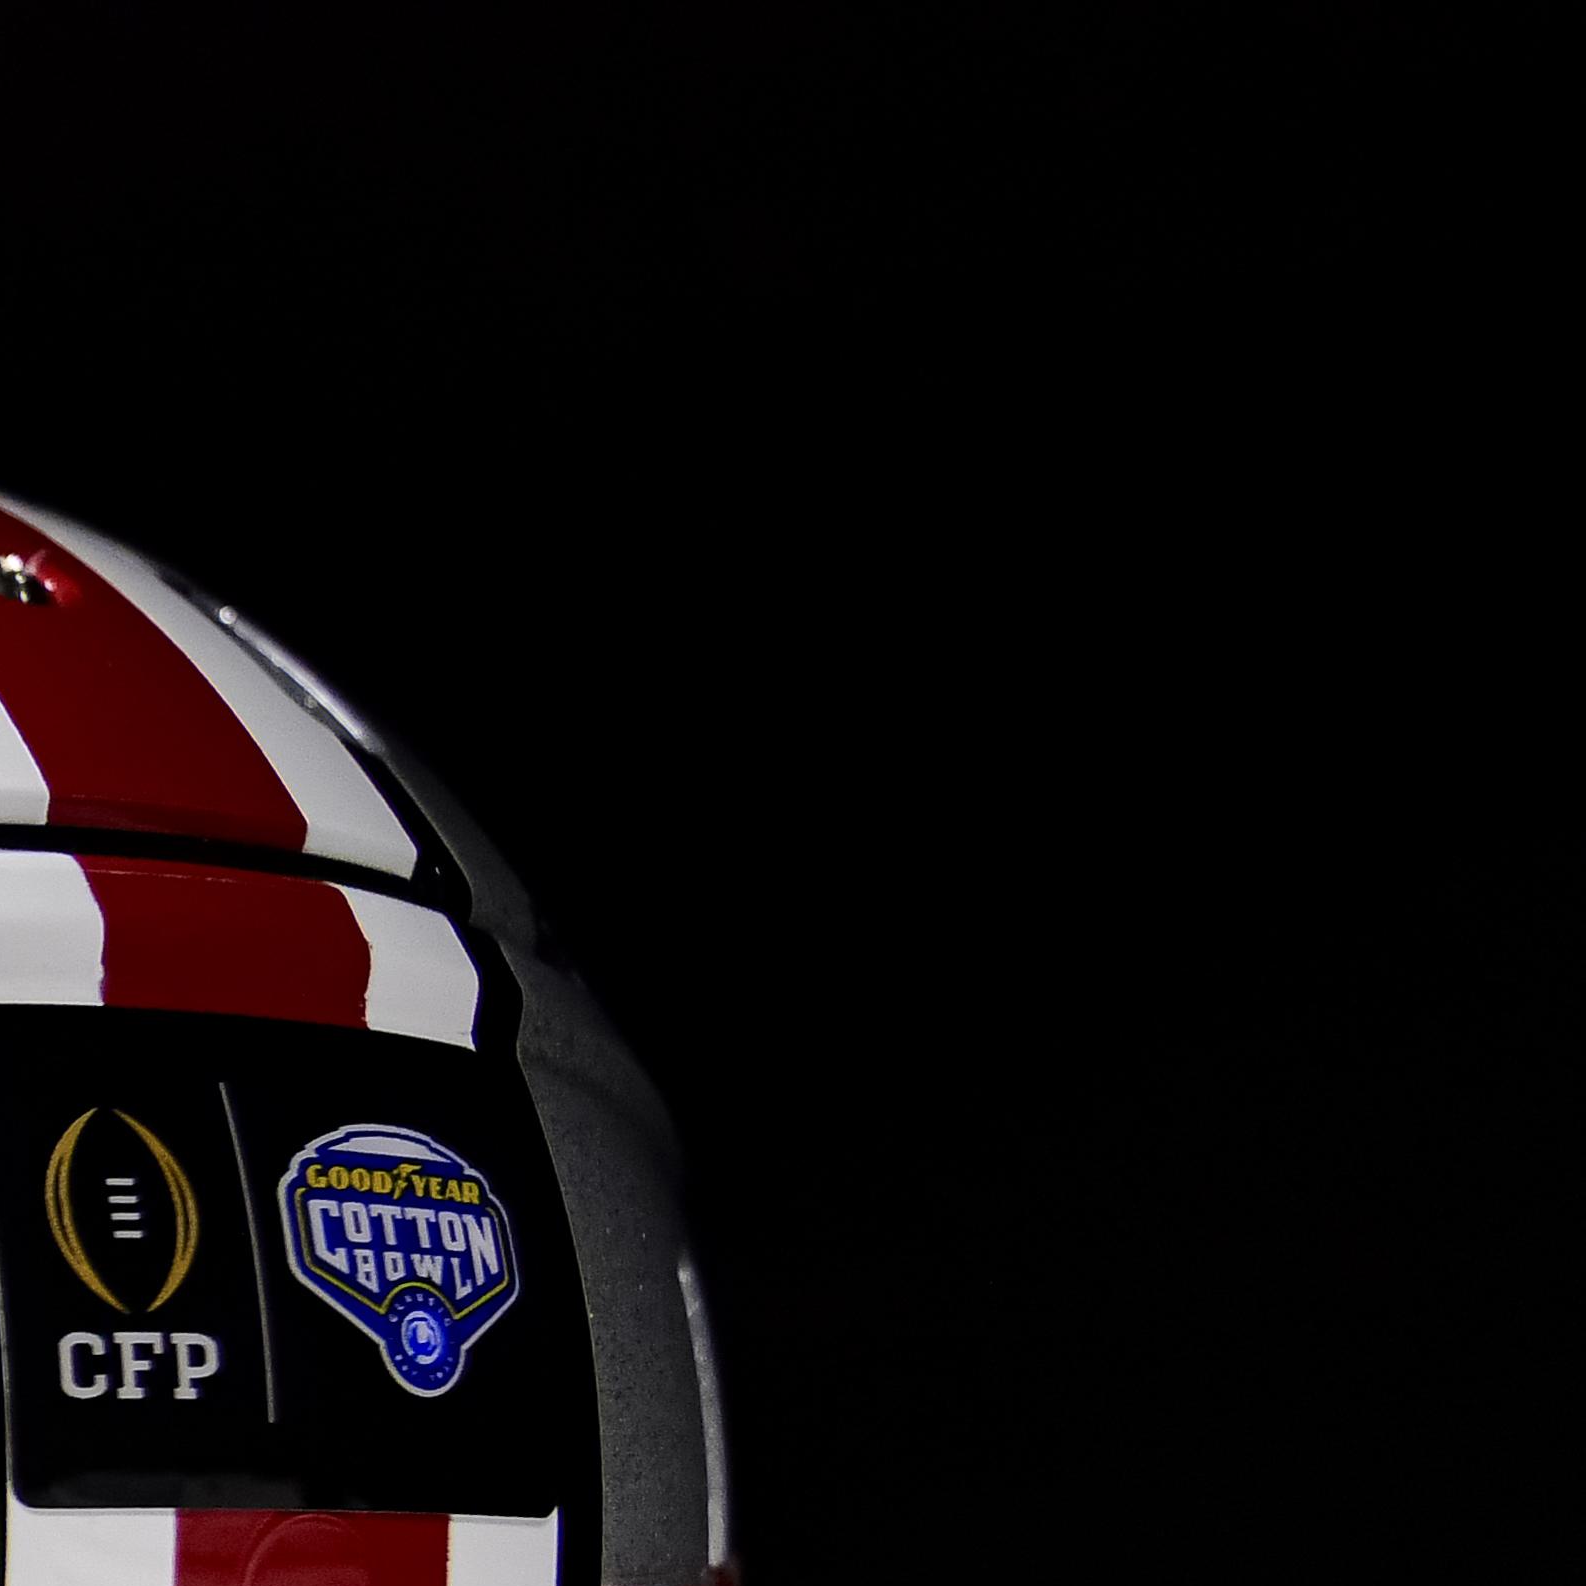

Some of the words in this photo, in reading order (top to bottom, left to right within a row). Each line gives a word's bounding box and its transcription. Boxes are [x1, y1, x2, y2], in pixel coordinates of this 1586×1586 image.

[307, 1199, 500, 1287] COTTON
[352, 1248, 472, 1300] BOWL
[57, 1331, 220, 1399] CFP
